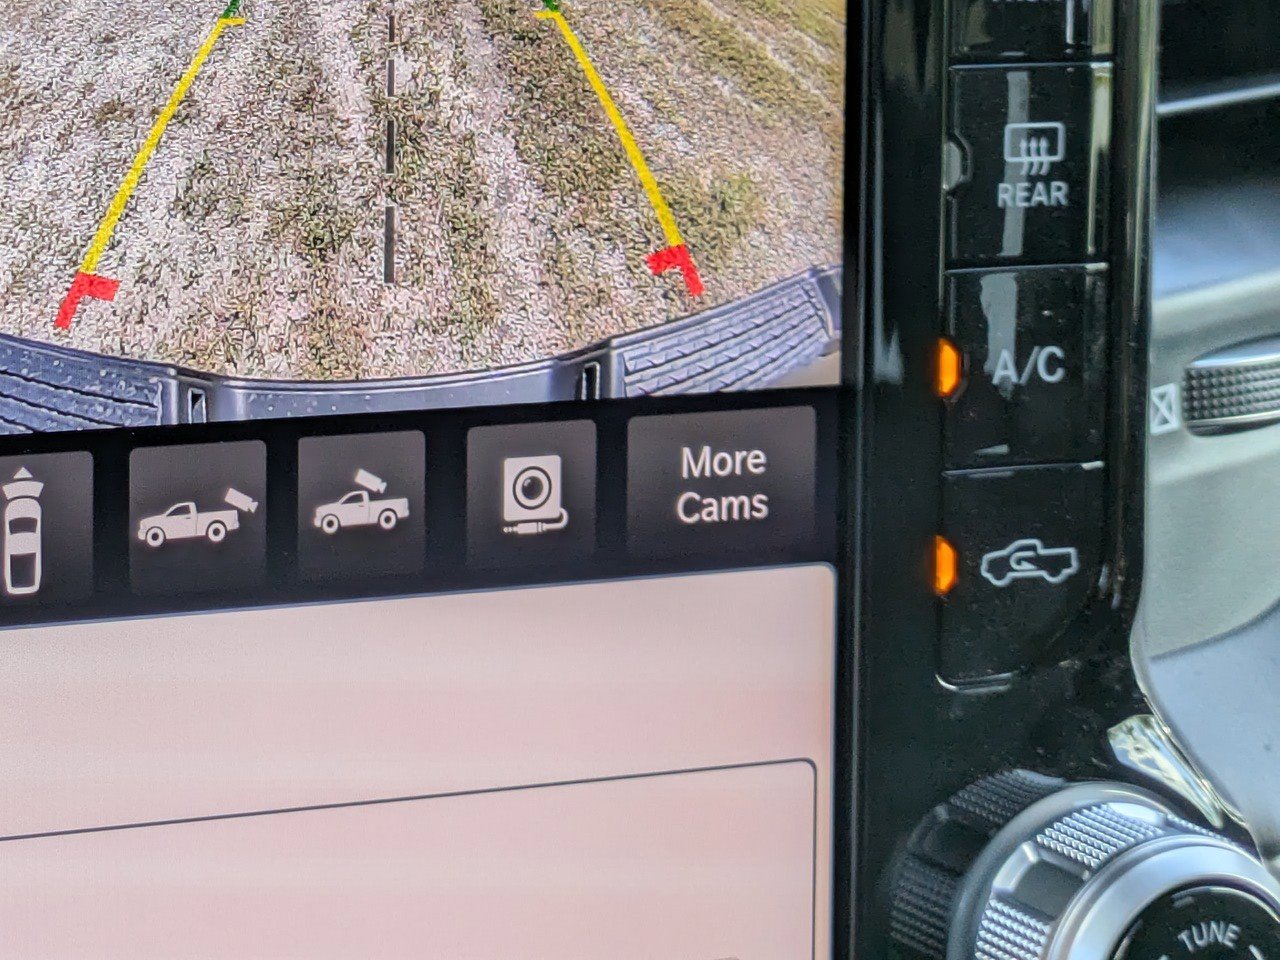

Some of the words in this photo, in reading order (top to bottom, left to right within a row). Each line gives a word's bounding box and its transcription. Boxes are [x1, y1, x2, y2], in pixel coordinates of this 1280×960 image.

[997, 180, 1069, 209] REAR
[991, 345, 1067, 386] A/C
[681, 446, 766, 479] More
[676, 490, 770, 525] Cams
[1177, 920, 1242, 954] TUNE
